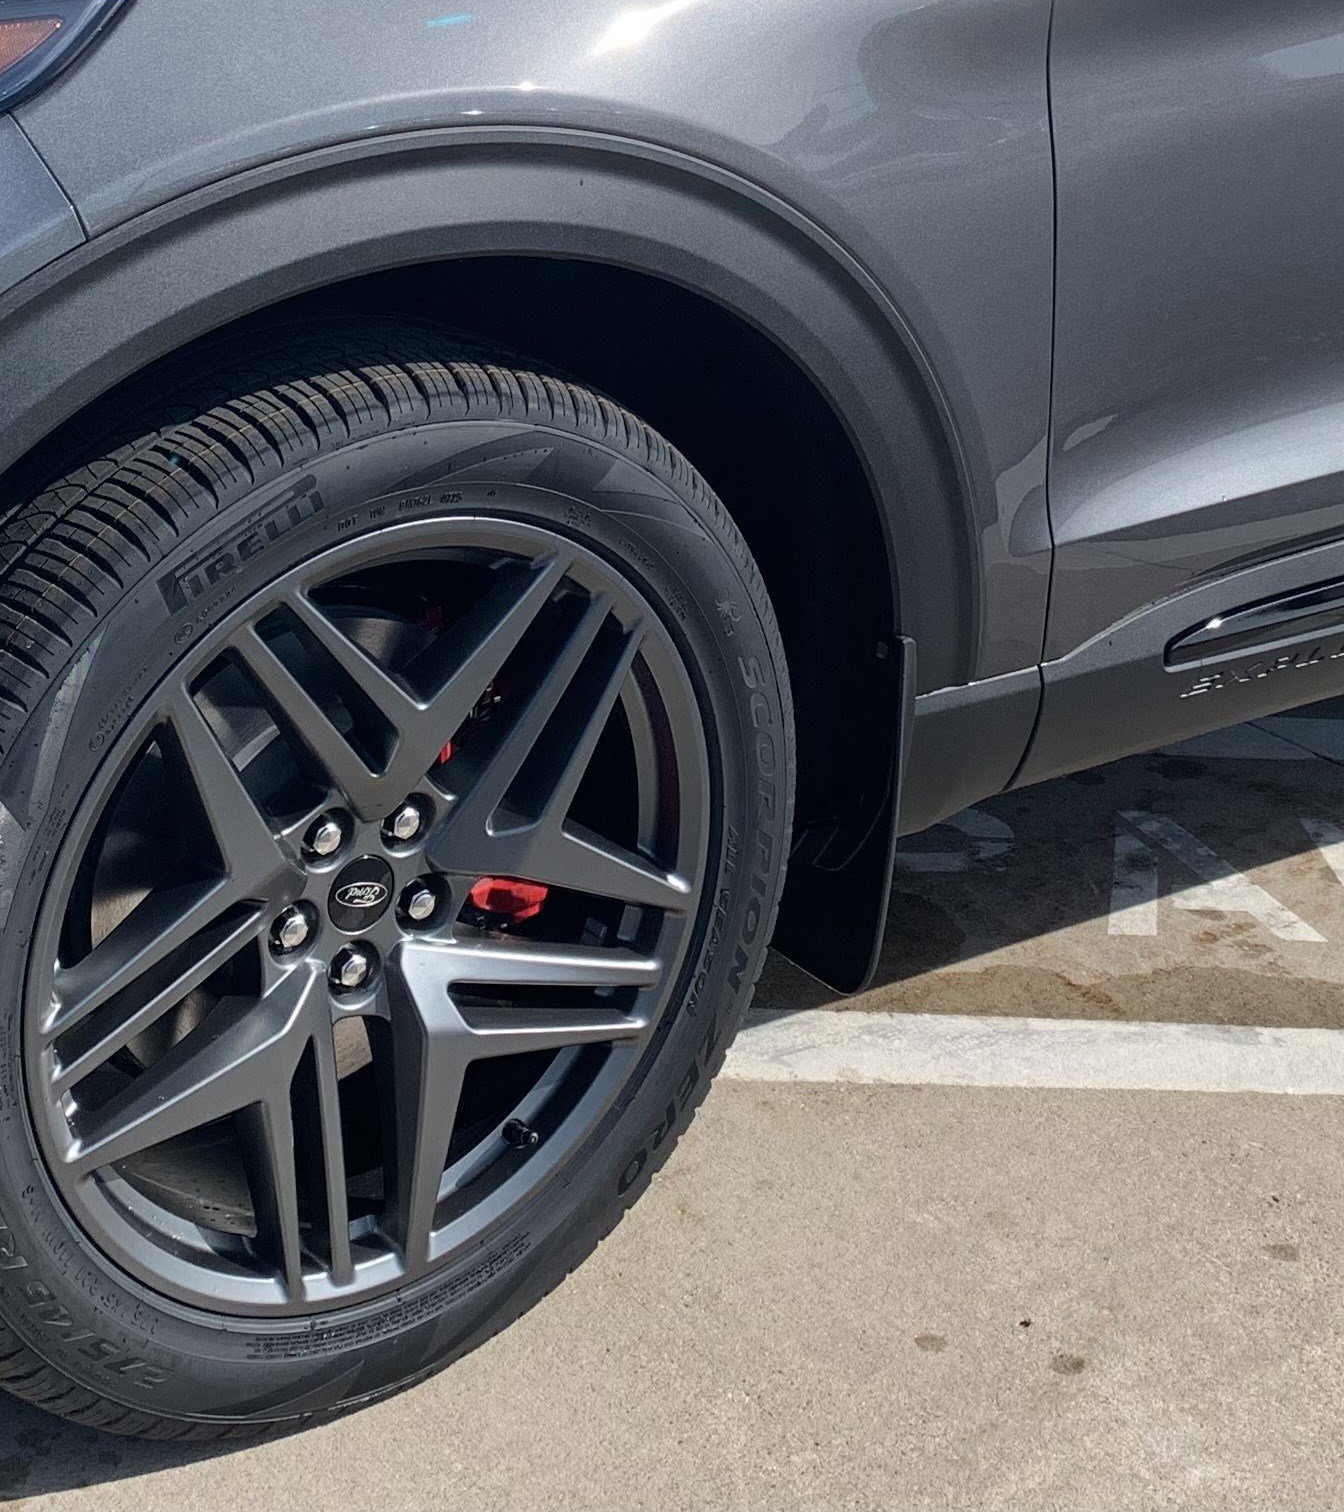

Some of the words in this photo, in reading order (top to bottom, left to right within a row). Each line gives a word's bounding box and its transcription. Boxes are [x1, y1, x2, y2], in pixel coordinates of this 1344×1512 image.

[156, 474, 325, 616] PIRELLI
[344, 886, 380, 903] Ford
[727, 655, 776, 995] SCORPION
[617, 1012, 721, 1199] ZERO
